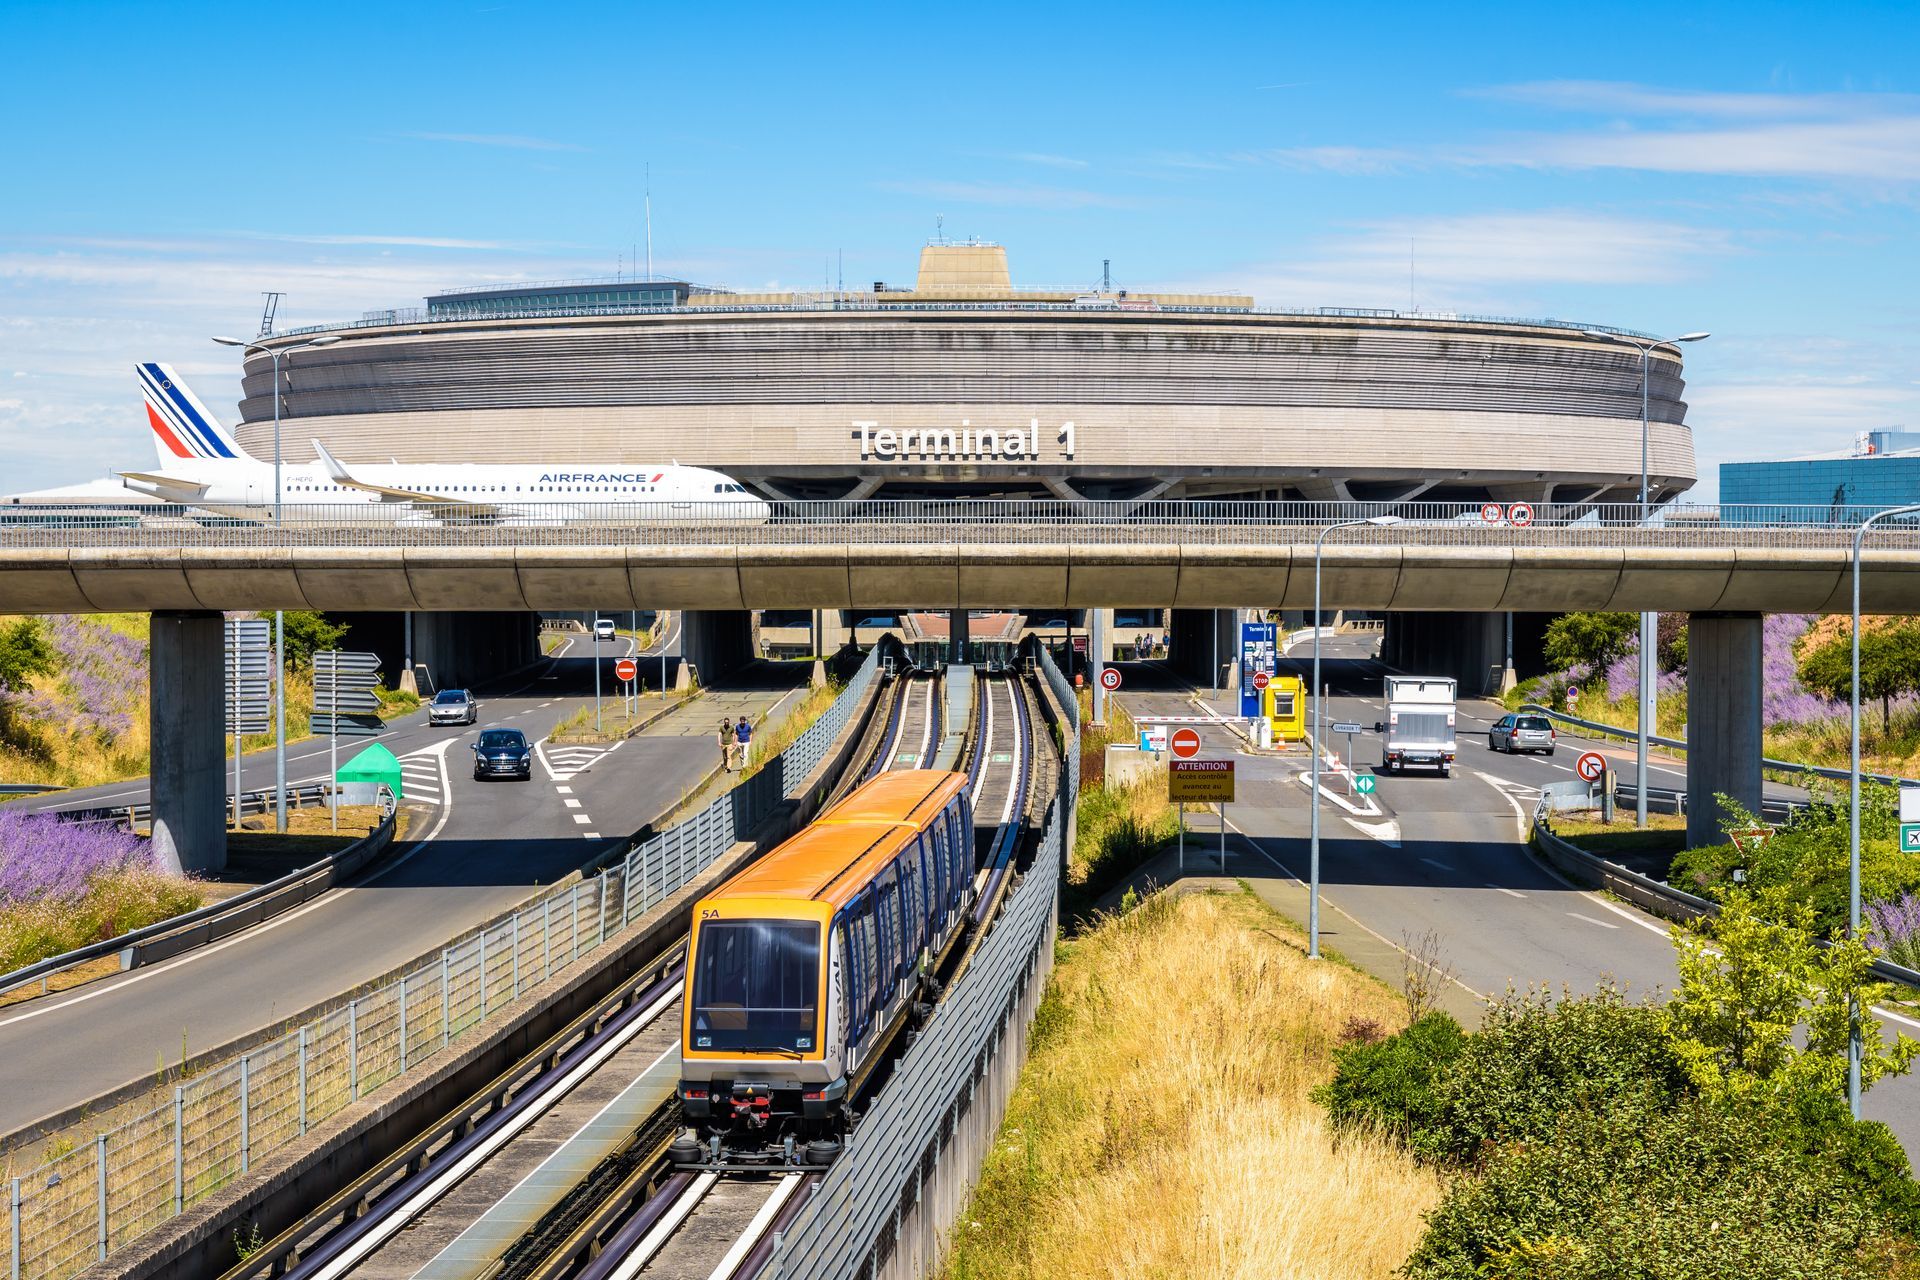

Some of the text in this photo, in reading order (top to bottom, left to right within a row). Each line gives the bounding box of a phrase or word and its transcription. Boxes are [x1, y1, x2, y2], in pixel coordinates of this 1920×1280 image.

[852, 418, 1075, 455] Terminal 1
[539, 473, 646, 483] AIRFRANCE
[1267, 626, 1272, 639] 1
[1105, 675, 1116, 684] 15
[1177, 762, 1228, 771] ATTENTION
[1209, 794, 1232, 802] badge
[702, 909, 720, 918] 5A
